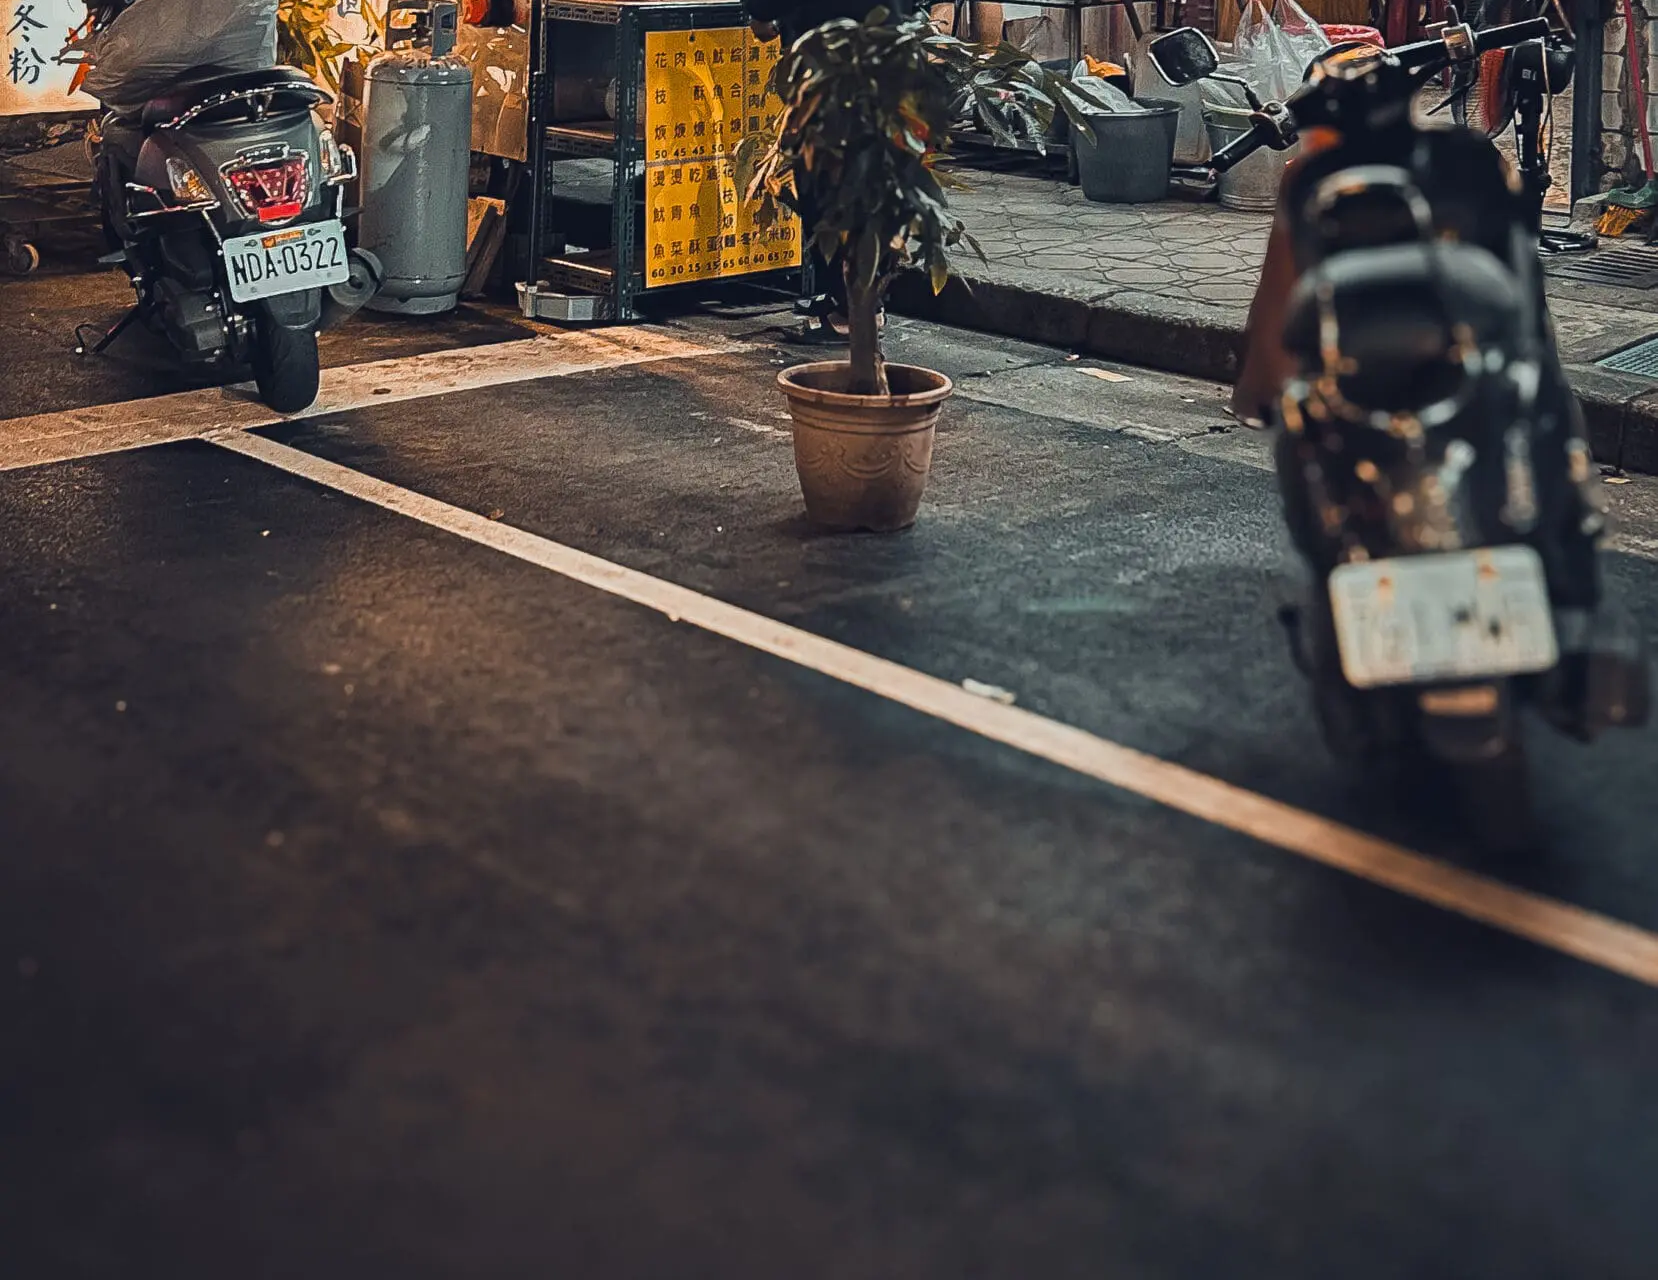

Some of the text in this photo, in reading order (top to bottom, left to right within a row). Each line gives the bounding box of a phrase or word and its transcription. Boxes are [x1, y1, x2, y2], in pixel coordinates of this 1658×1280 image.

[655, 149, 667, 159] 50
[673, 147, 686, 157] 45
[692, 145, 705, 155] 45
[712, 143, 724, 153] 50
[231, 237, 342, 286] NDA-0322
[652, 249, 794, 278] 60 30 15 15 65 60 60 65 70
